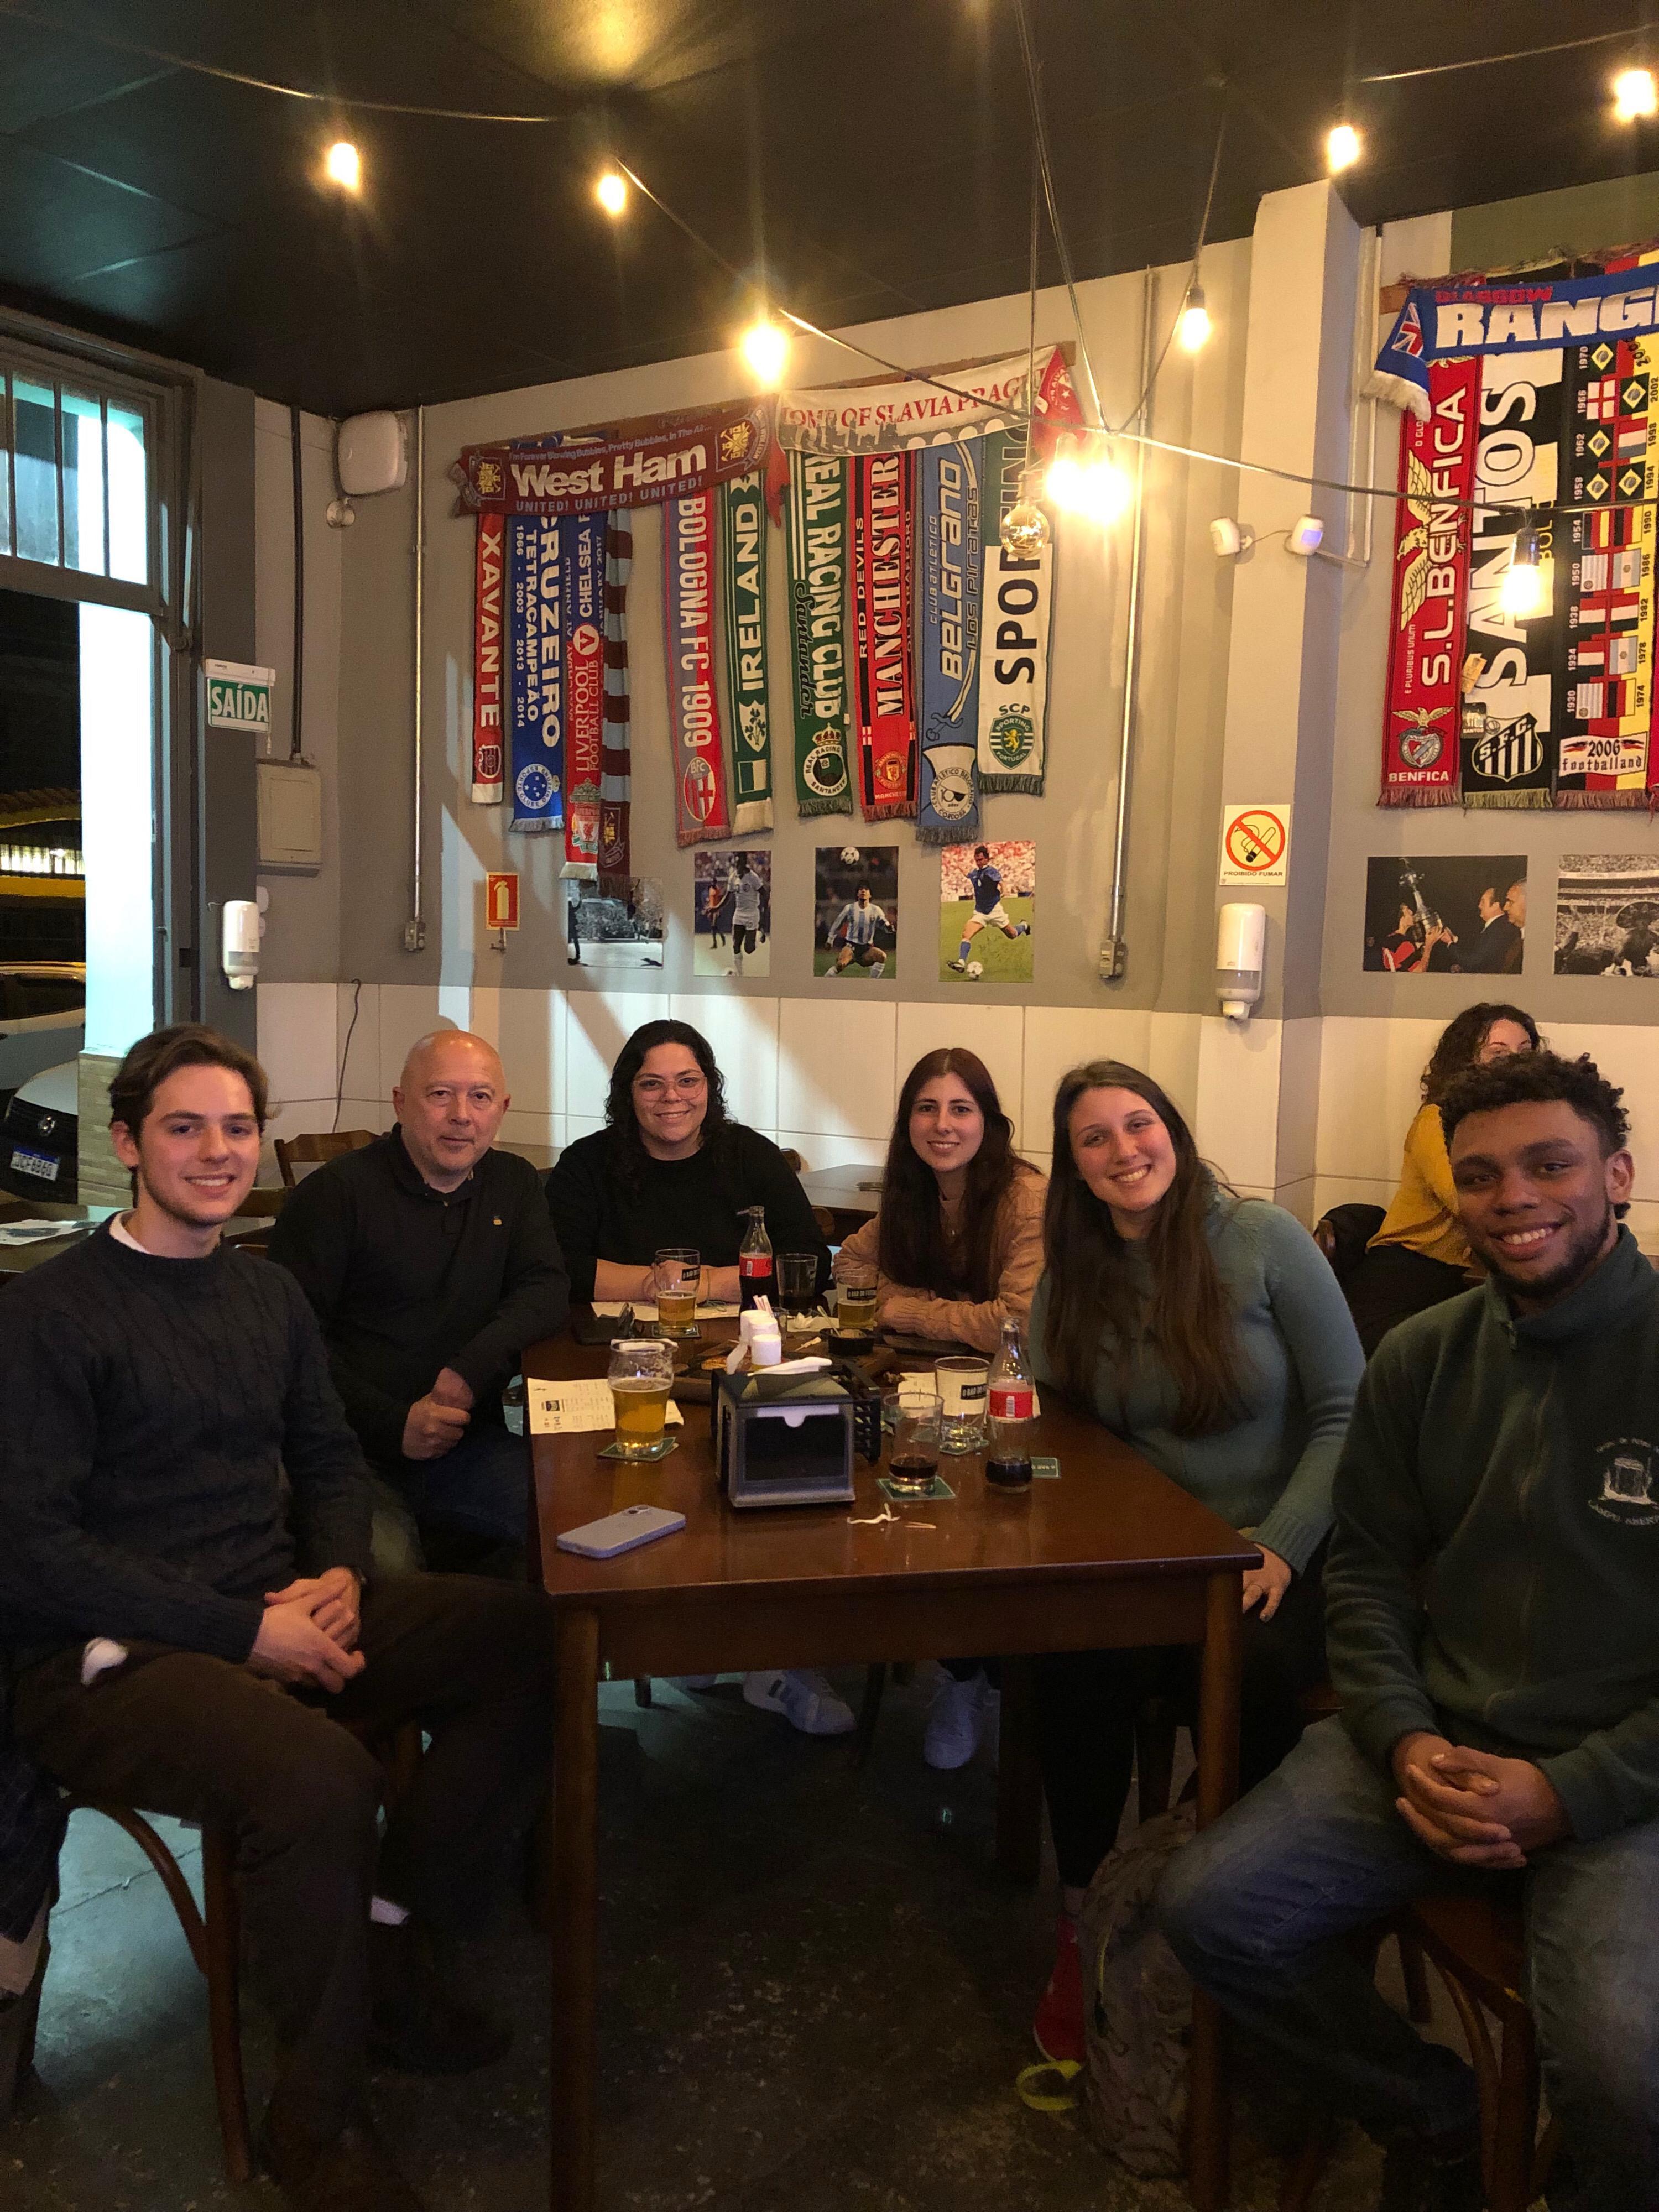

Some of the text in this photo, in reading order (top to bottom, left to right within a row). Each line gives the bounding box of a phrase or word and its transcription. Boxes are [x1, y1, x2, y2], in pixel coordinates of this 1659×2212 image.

[1436, 286, 1659, 348] RANG
[1579, 346, 1589, 369] 1970
[841, 407, 872, 427] OF
[875, 395, 953, 425] SLAVIA
[1577, 390, 1587, 413] 1966
[547, 449, 576, 460] Blowing
[677, 429, 693, 439] The
[1576, 434, 1585, 457] 1962
[1648, 422, 1657, 446] 1998
[510, 444, 707, 497] West Ham
[1646, 466, 1655, 490] 1994
[515, 476, 703, 512] UNITED! UNITED! UNITED!
[1573, 519, 1582, 543] 1954
[1644, 510, 1652, 534] 1990
[578, 528, 592, 618] CHELSEA
[1572, 563, 1580, 586] 1950
[1641, 554, 1650, 577] 1986
[806, 522, 842, 638] RACING
[855, 517, 867, 658] RED DEVILS
[870, 454, 902, 718] MANCHESTER
[735, 501, 763, 692] IRELAND
[928, 587, 938, 625] CLUB
[1640, 598, 1648, 622] 1982
[481, 531, 501, 728] XAVANTE
[678, 497, 713, 748] BOLOGNA FC 1909
[1569, 606, 1579, 629] 1938
[516, 639, 524, 671] 2013
[794, 581, 817, 719] Santander
[1568, 648, 1577, 671] 1934
[1639, 641, 1647, 664] 1978
[812, 643, 843, 719] CLUB
[1405, 649, 1415, 688] PLURIBUS
[211, 684, 269, 722] SAÍDA
[999, 703, 1030, 716] SCP
[1567, 690, 1576, 713] 1930
[1636, 685, 1645, 708] 1974
[517, 696, 525, 728] 2014
[575, 661, 590, 772] LIVERPOOL
[588, 660, 599, 771] FOOTBALL CLUB
[995, 718, 1030, 731] SPORTING
[805, 746, 841, 774] REAL RACING
[996, 751, 1027, 762] PORTUGAL
[1587, 739, 1621, 758] 2006
[811, 778, 846, 794] SANTANDER
[1389, 771, 1449, 782] BENFICA
